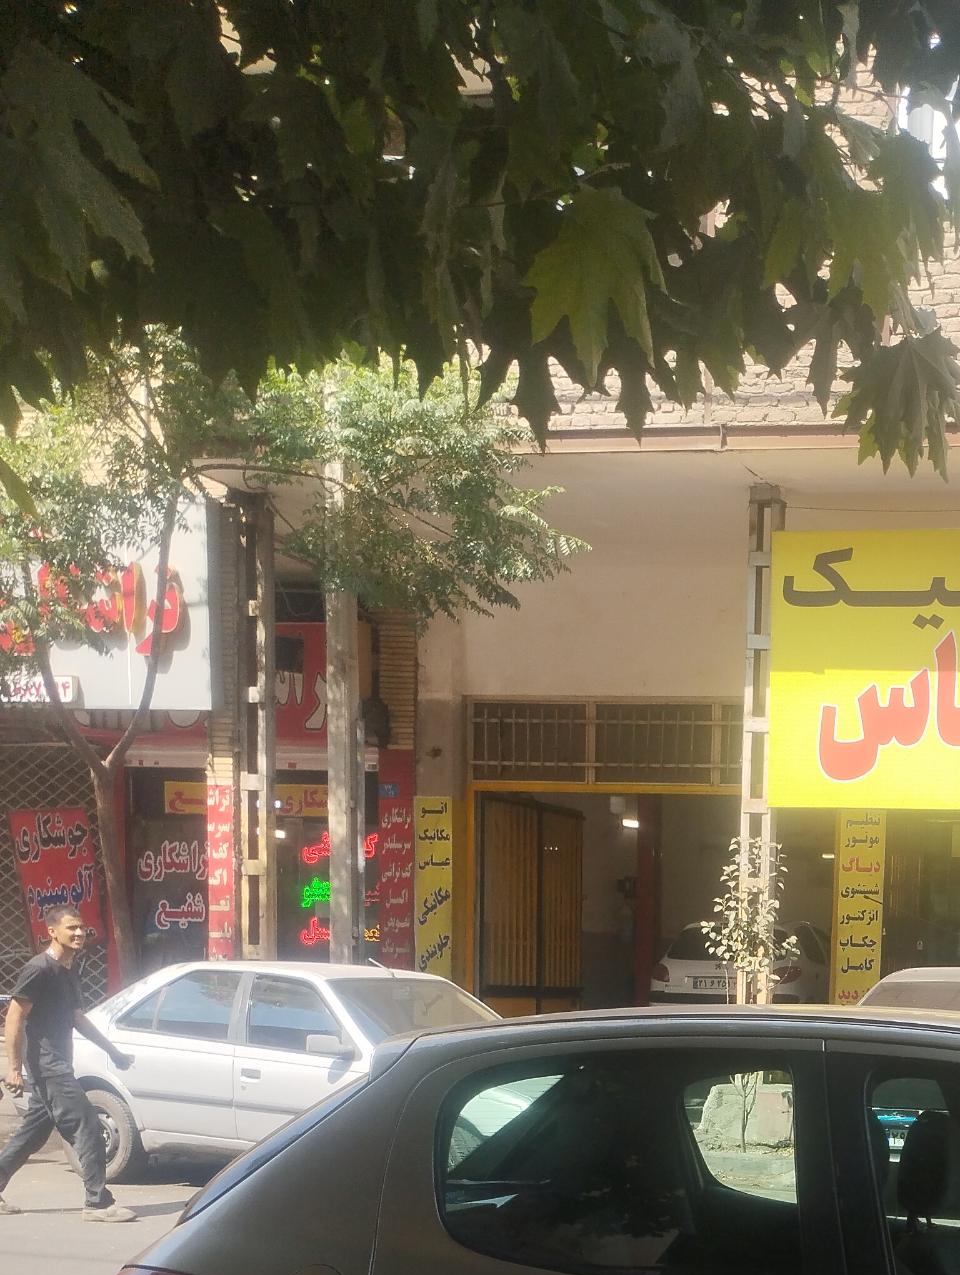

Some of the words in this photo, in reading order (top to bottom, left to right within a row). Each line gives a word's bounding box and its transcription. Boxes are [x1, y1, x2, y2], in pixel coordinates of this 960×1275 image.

[846, 811, 881, 828] تنظیم
[15, 813, 89, 864] جوشکاری
[418, 828, 450, 845] مکانیک
[844, 831, 880, 849] موتور
[418, 853, 450, 870] عباس
[841, 855, 881, 876] دیاگ
[840, 883, 880, 899] شستشوی
[155, 892, 206, 930] شفیع
[418, 887, 450, 926] مکانیکی
[839, 909, 879, 926] انژکتور
[839, 934, 877, 952] چکاپ
[841, 956, 875, 974] کامل
